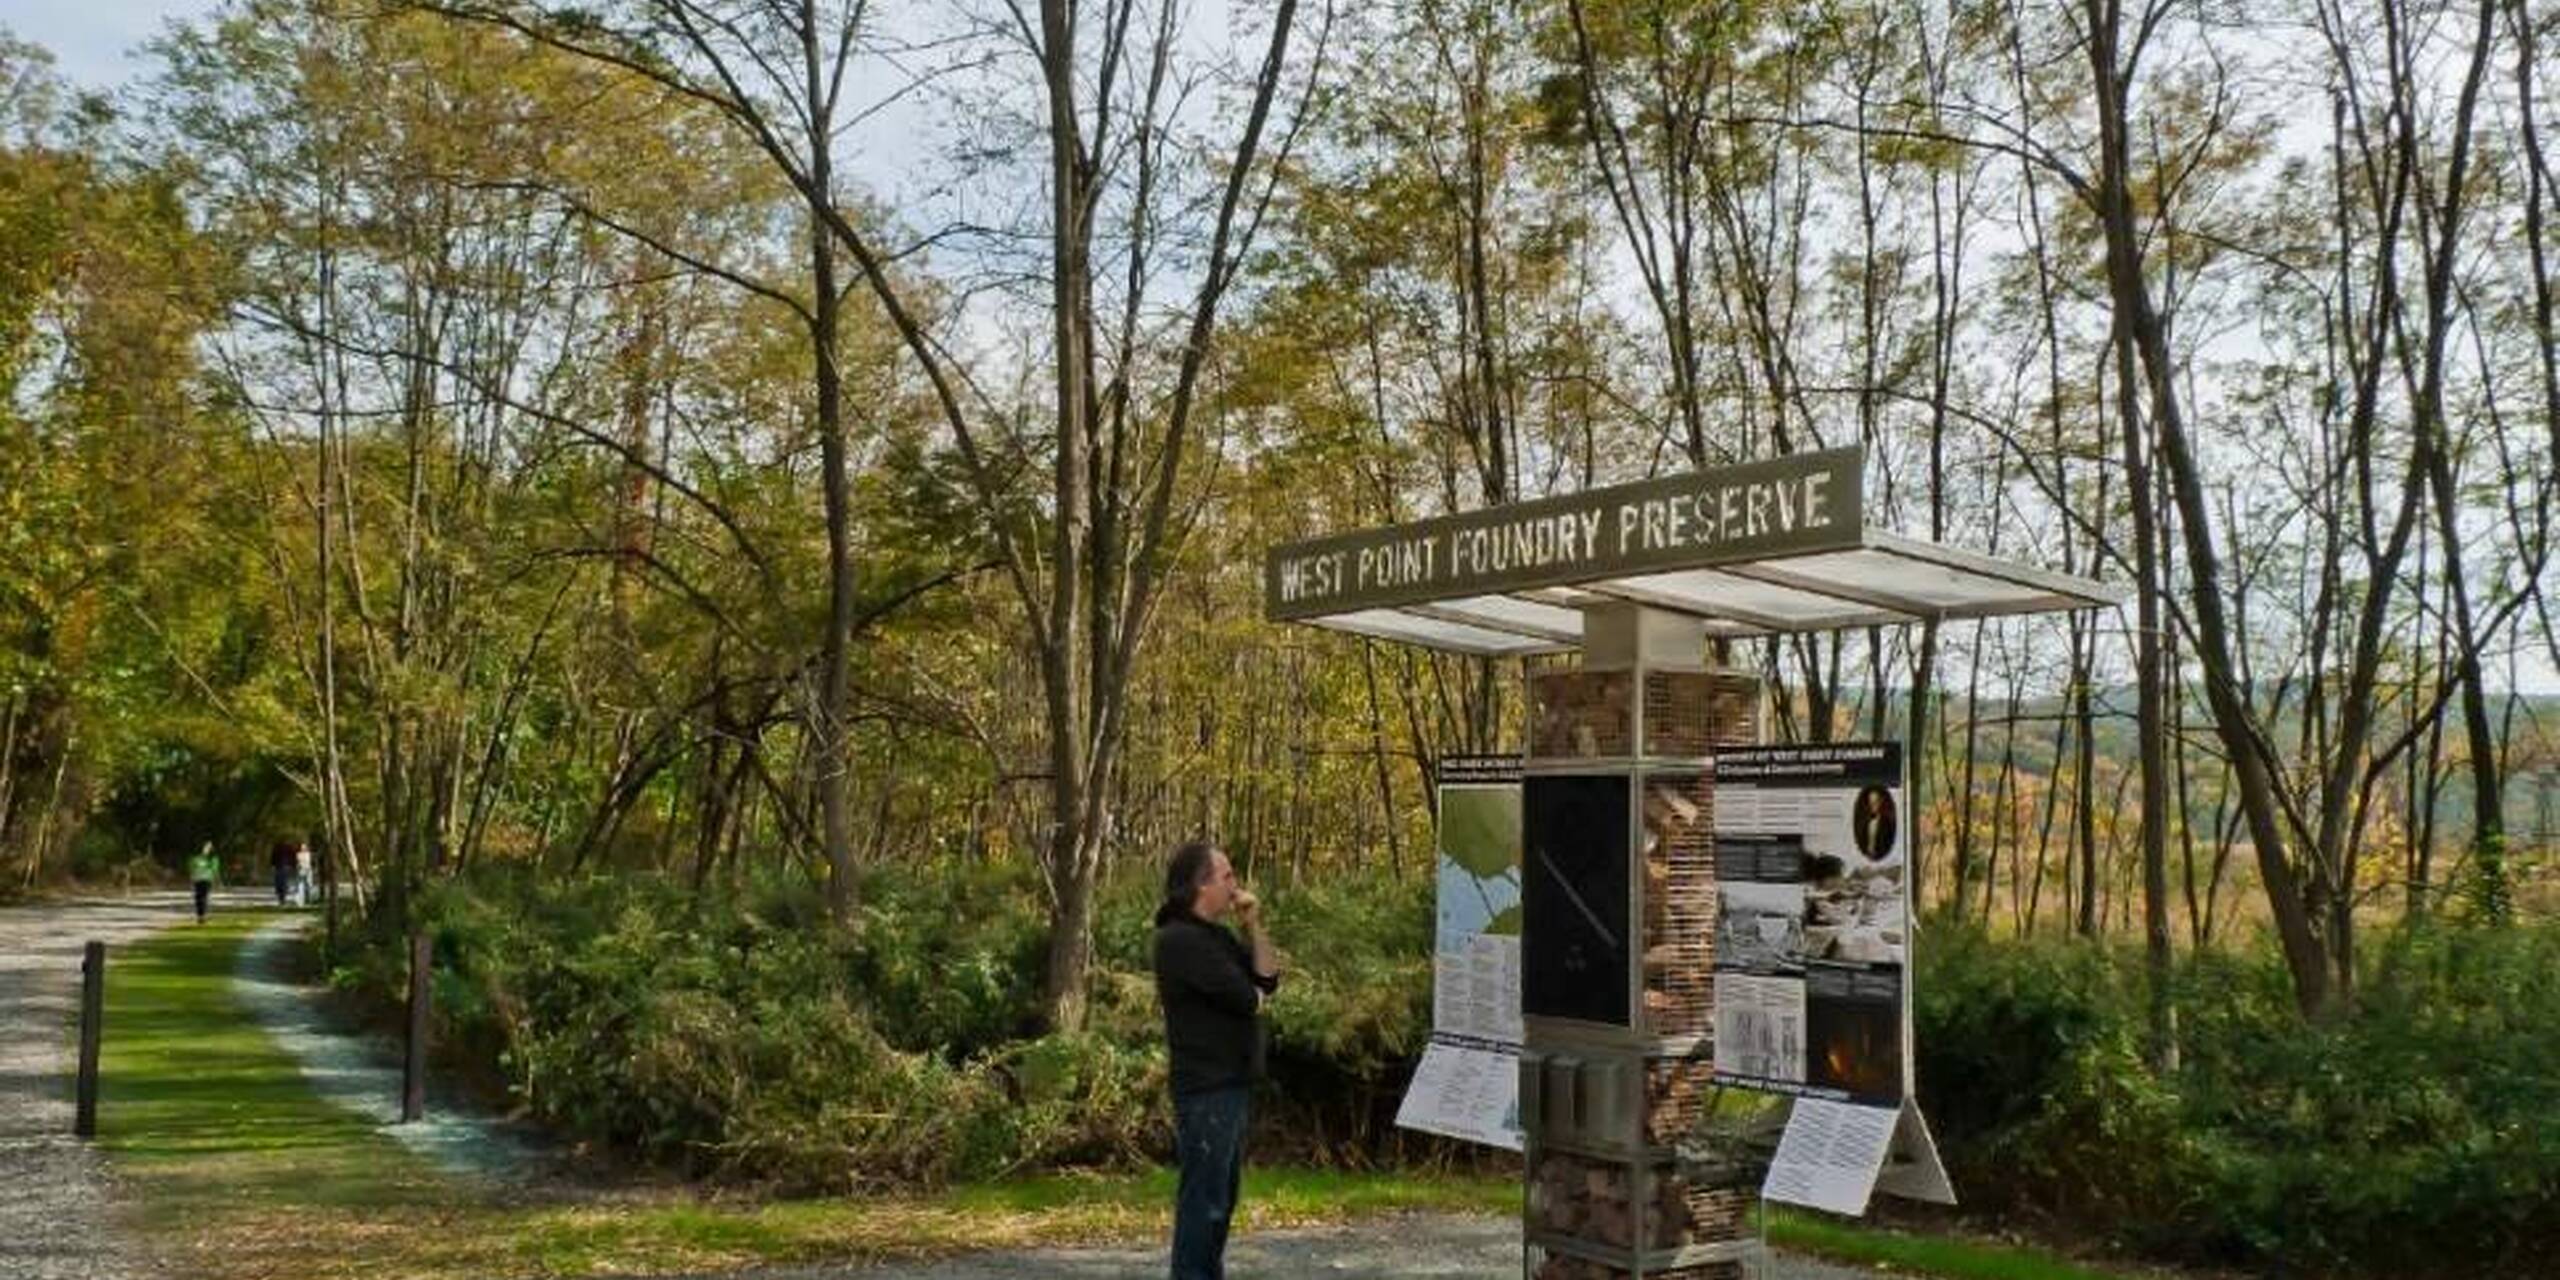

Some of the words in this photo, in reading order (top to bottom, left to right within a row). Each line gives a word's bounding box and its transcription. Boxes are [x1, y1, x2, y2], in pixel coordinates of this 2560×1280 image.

[1281, 550, 1348, 601] WEST
[1358, 535, 1439, 591] POINT
[1452, 508, 1602, 578] FOUNDRY
[1619, 471, 1832, 554] PRESERVE
